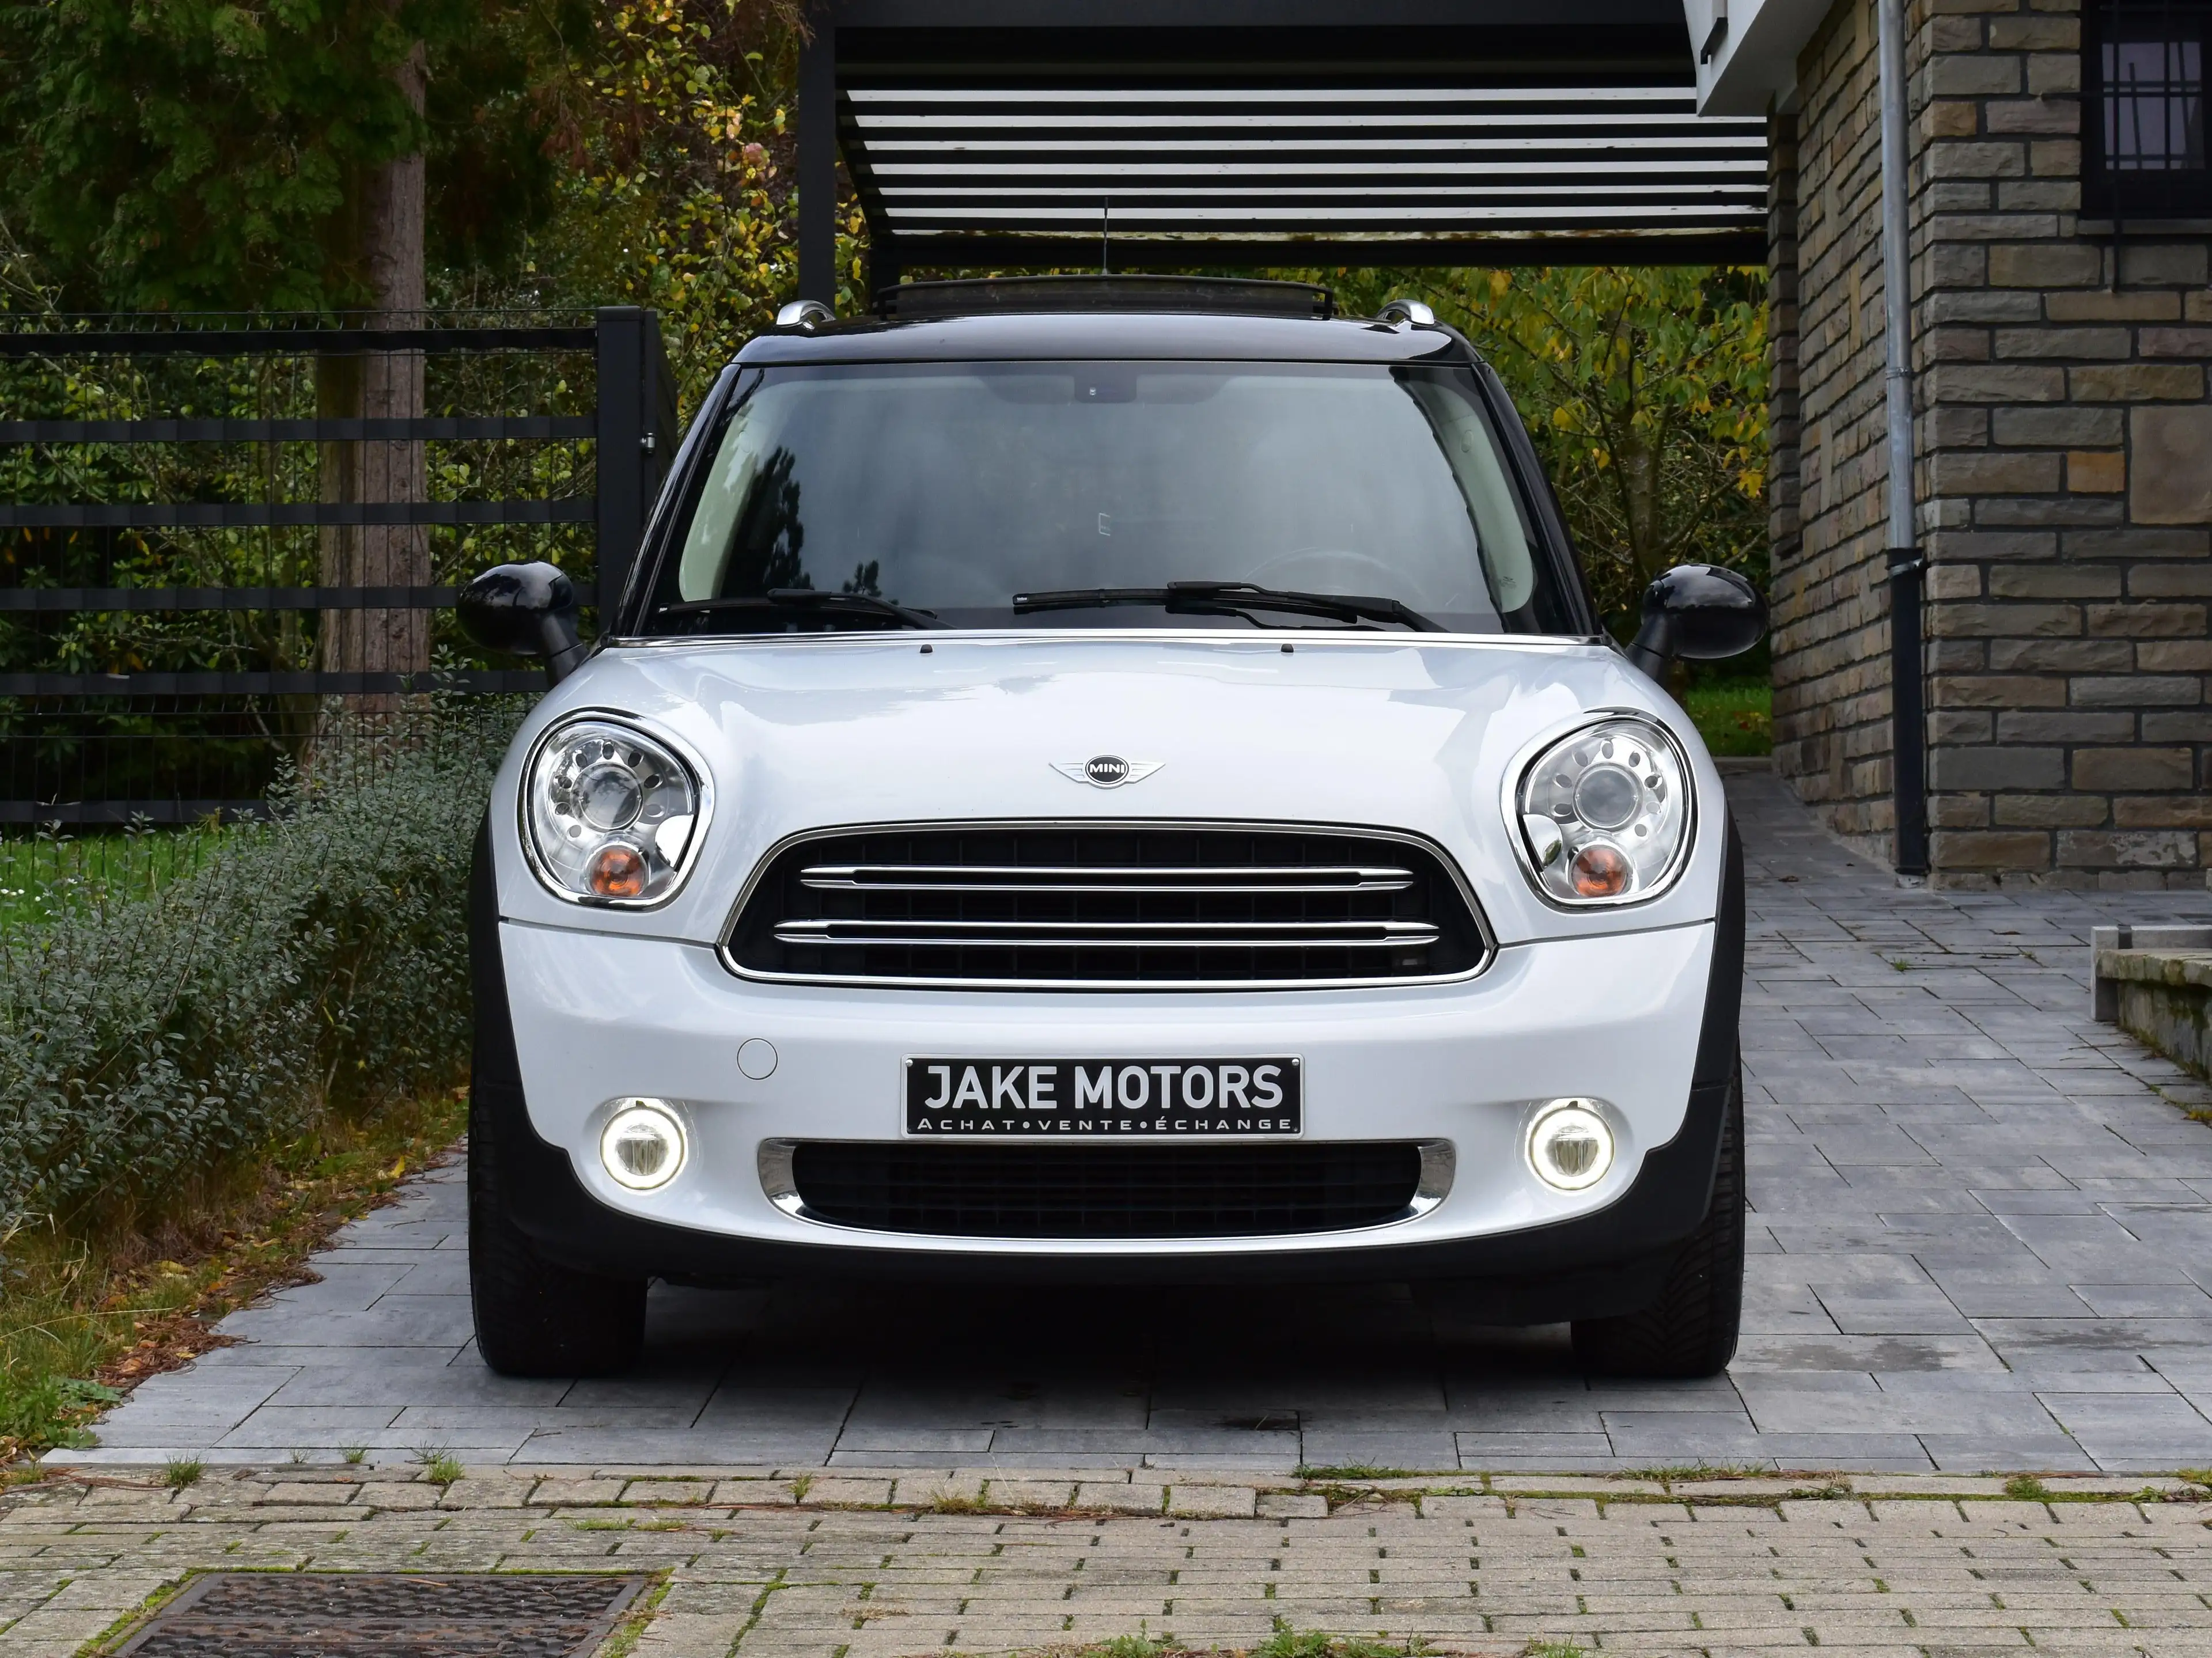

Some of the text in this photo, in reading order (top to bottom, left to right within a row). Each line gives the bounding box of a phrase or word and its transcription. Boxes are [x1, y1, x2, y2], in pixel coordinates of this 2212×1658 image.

[1089, 763, 1125, 773] MINI
[925, 1065, 1283, 1109] JAKE MOTORS
